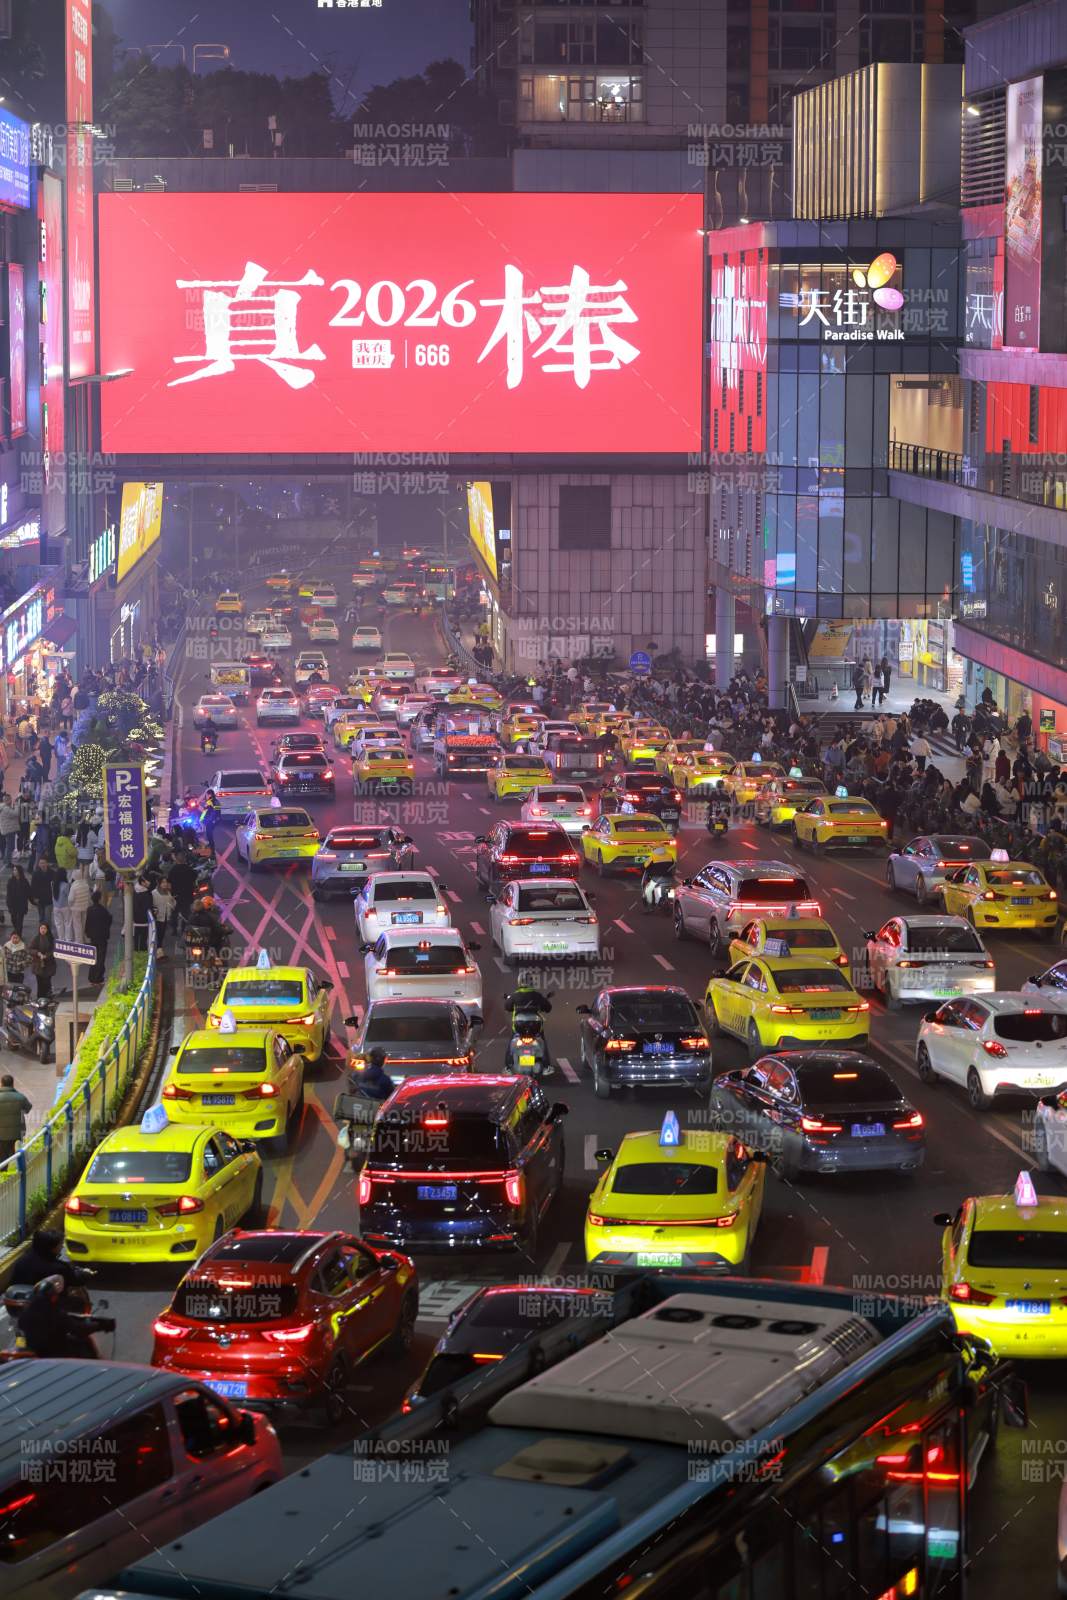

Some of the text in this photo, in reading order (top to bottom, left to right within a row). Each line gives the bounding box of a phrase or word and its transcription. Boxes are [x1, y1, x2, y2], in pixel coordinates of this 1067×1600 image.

[798, 289, 870, 327] 天街
[166, 261, 327, 389] 真
[329, 279, 477, 328] 2026
[477, 264, 641, 390] 棒
[824, 329, 905, 341] Paradise Walk
[414, 343, 450, 367] 666
[115, 770, 132, 792] P
[118, 795, 134, 859] 宏福俊悦
